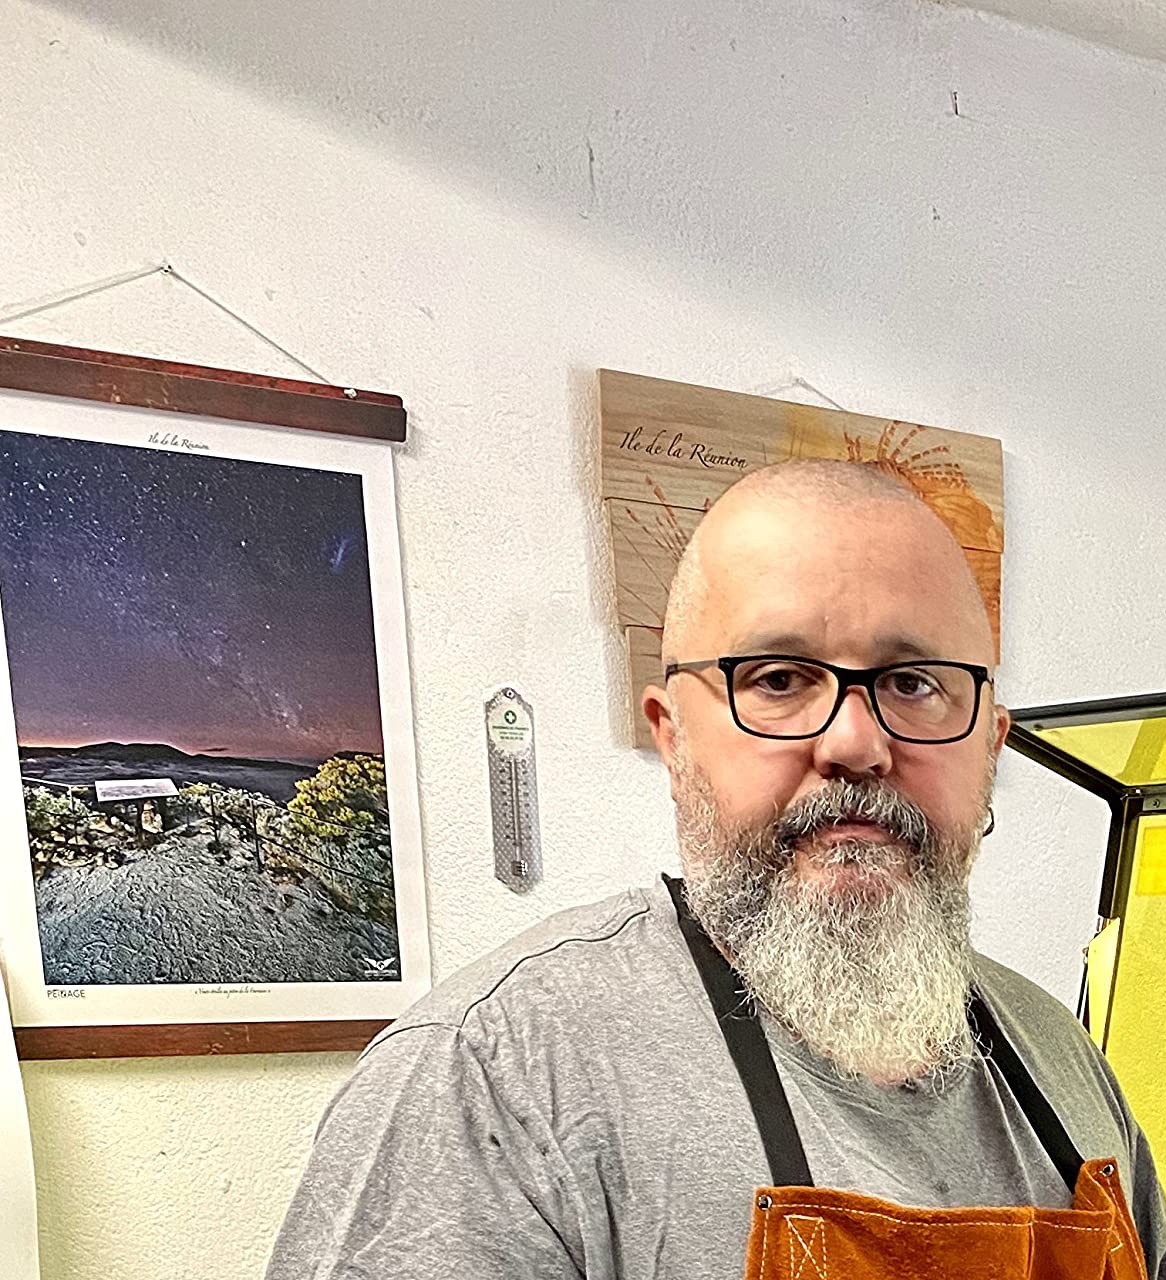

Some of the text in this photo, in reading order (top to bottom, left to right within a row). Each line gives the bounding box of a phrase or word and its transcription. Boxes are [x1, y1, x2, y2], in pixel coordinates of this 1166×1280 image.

[620, 427, 748, 468] Ile de la Réunion
